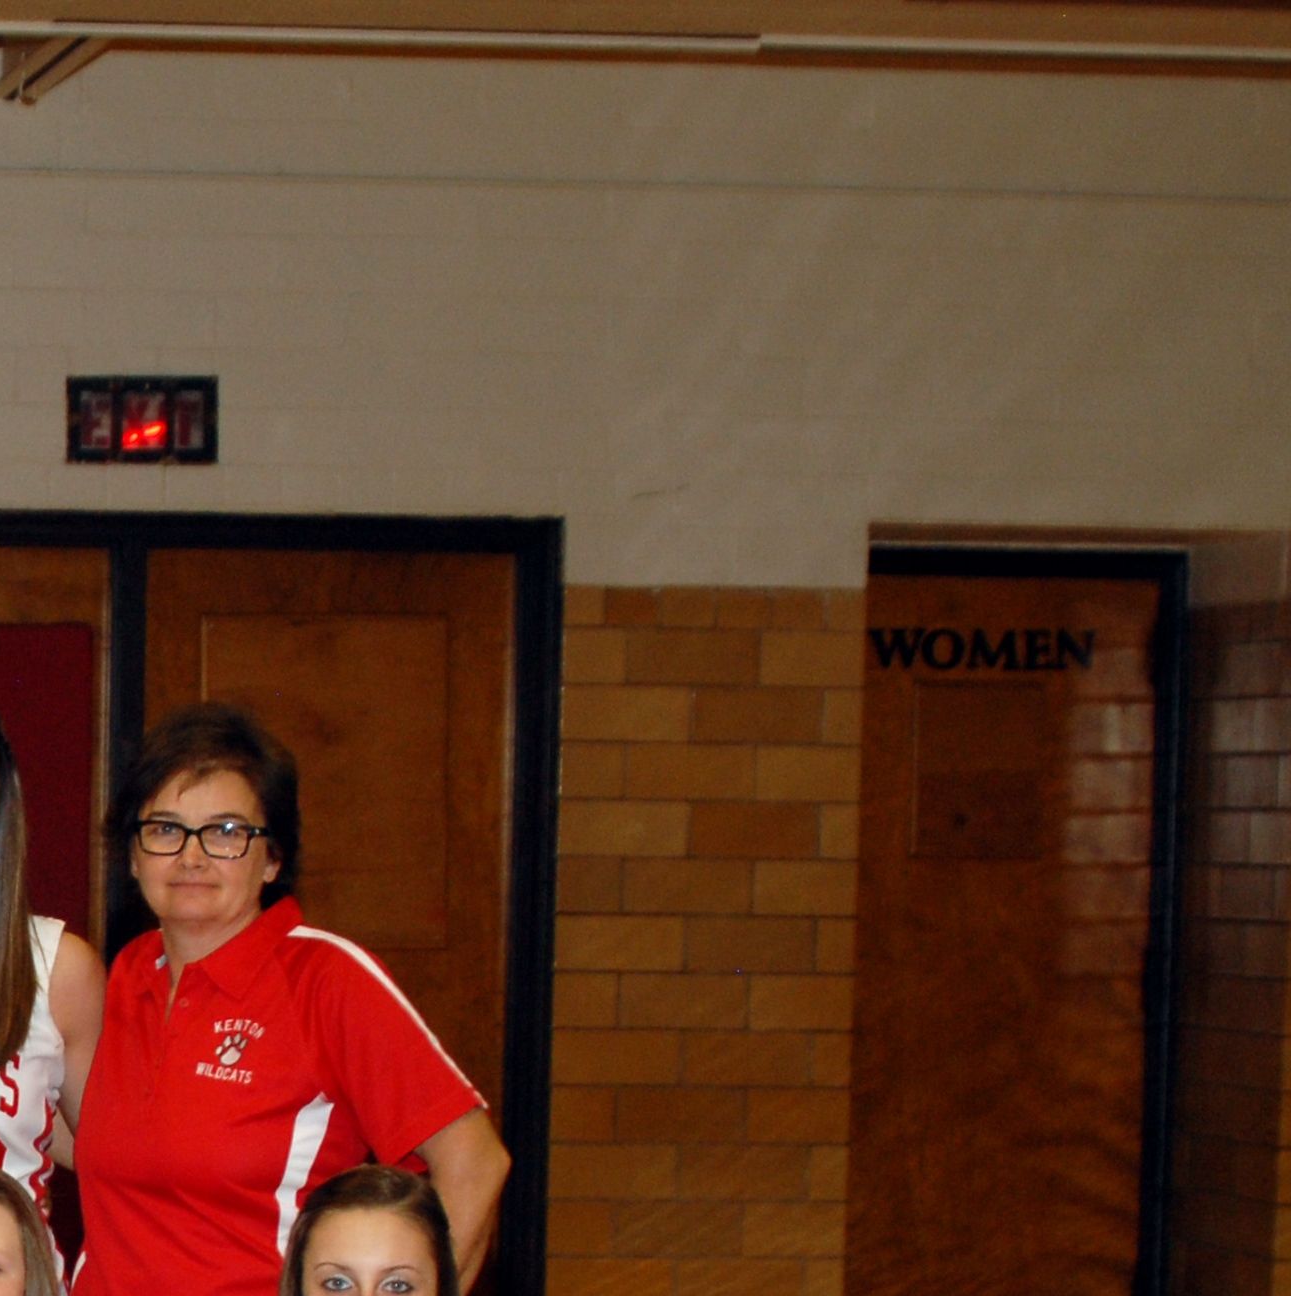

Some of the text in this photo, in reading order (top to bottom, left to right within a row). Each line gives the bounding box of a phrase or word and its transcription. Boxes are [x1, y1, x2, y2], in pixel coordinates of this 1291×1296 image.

[869, 628, 1097, 671] WOMEN
[214, 1019, 265, 1039] KENTON
[195, 1061, 253, 1084] WILDCATS
